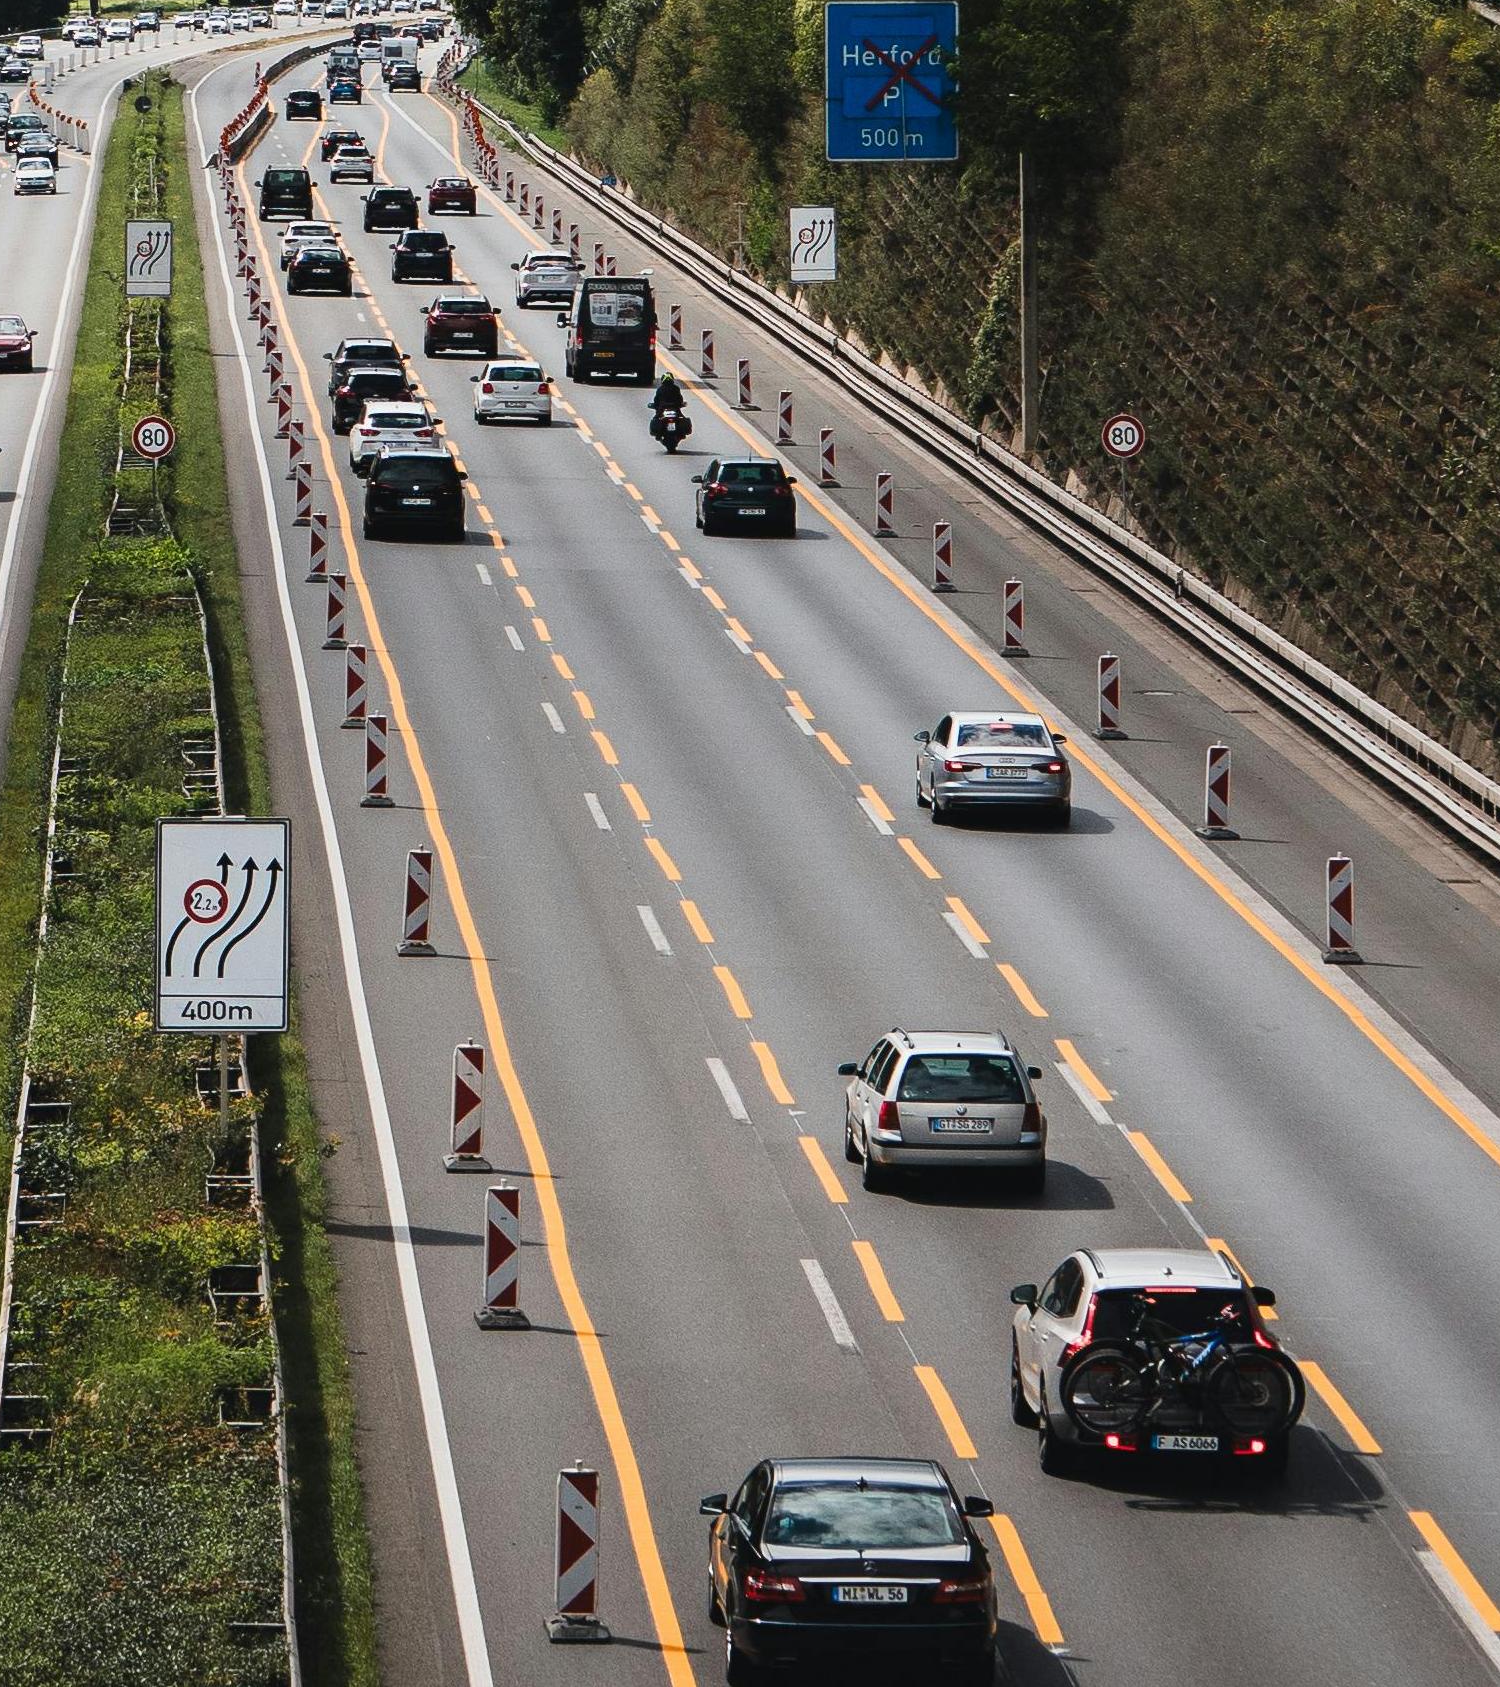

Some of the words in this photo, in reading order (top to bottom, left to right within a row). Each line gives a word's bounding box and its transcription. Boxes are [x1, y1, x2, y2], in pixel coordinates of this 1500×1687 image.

[883, 86, 900, 107] P
[861, 128, 899, 147] 500
[142, 428, 165, 446] 80
[1112, 427, 1136, 445] 80
[180, 1000, 253, 1021] 400m
[888, 1587, 904, 1600] 56
